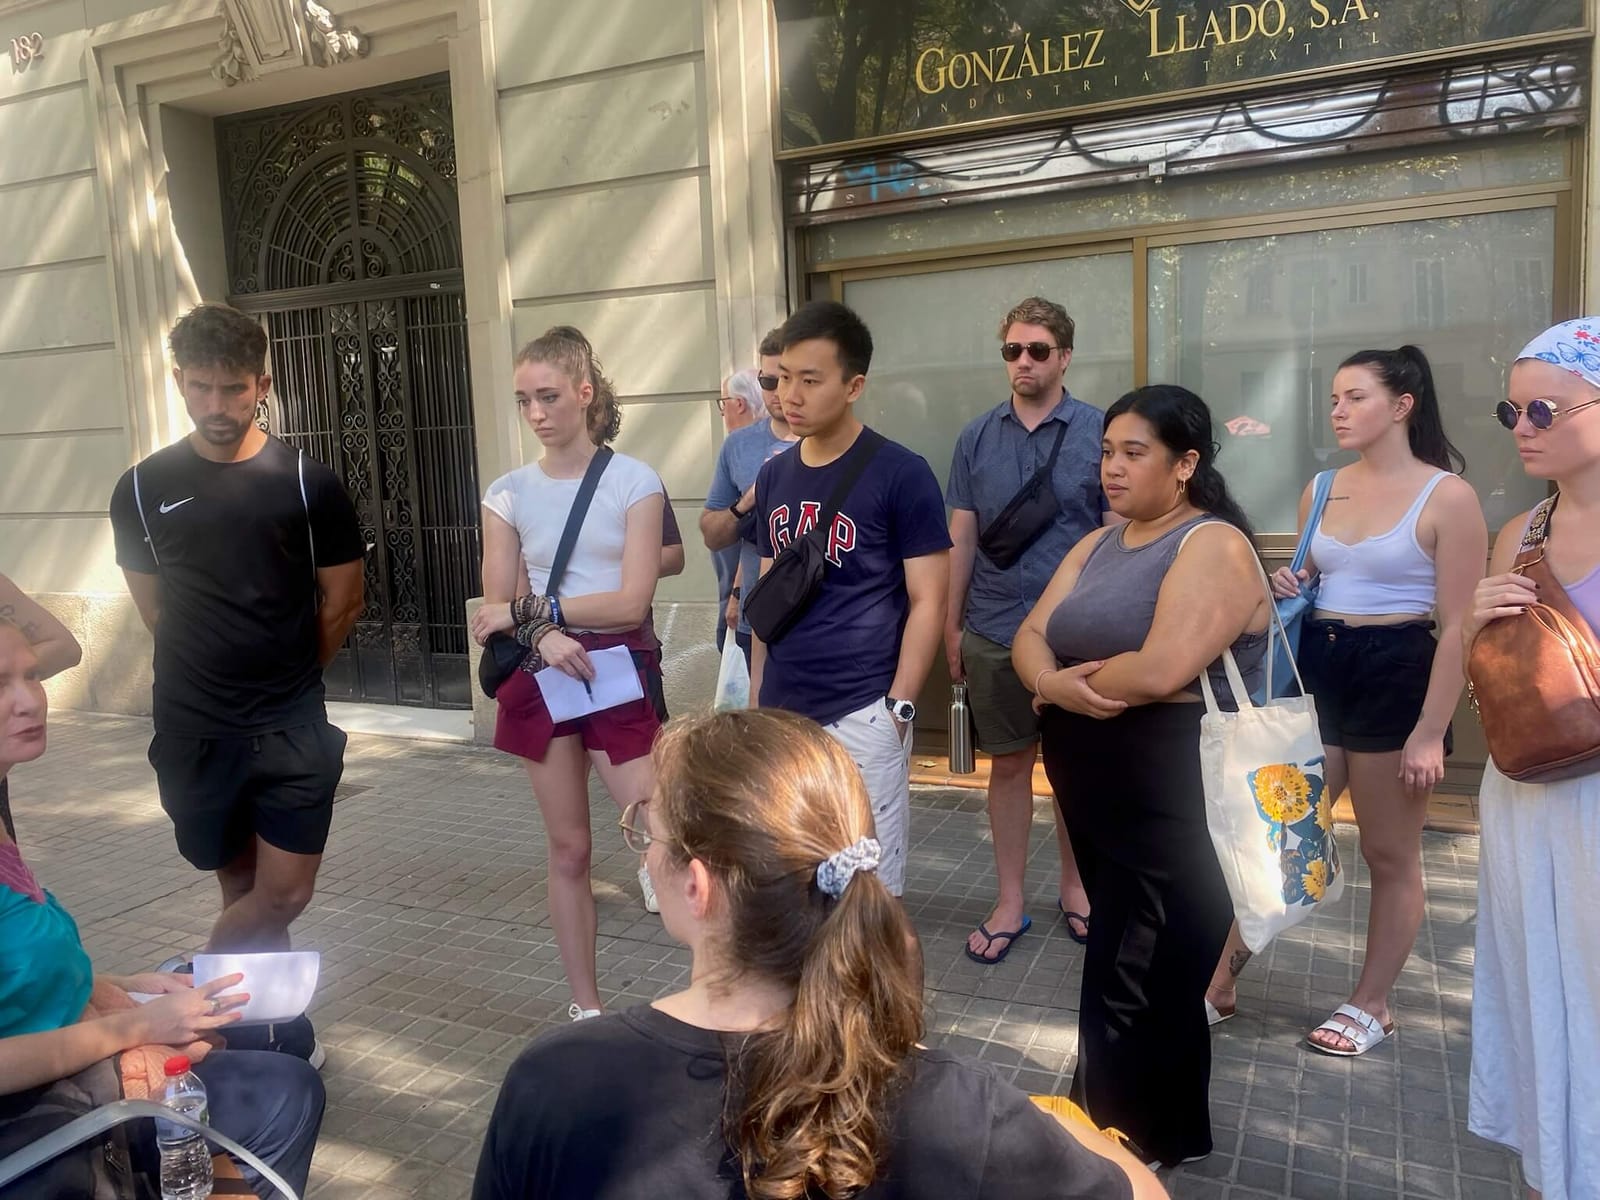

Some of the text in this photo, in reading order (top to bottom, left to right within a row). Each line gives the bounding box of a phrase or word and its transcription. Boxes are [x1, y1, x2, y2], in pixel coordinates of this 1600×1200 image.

[1310, 0, 1380, 29] S.A.
[916, 31, 1380, 118] INDUSTRIA TEXTIL
[769, 501, 857, 568] GAP
